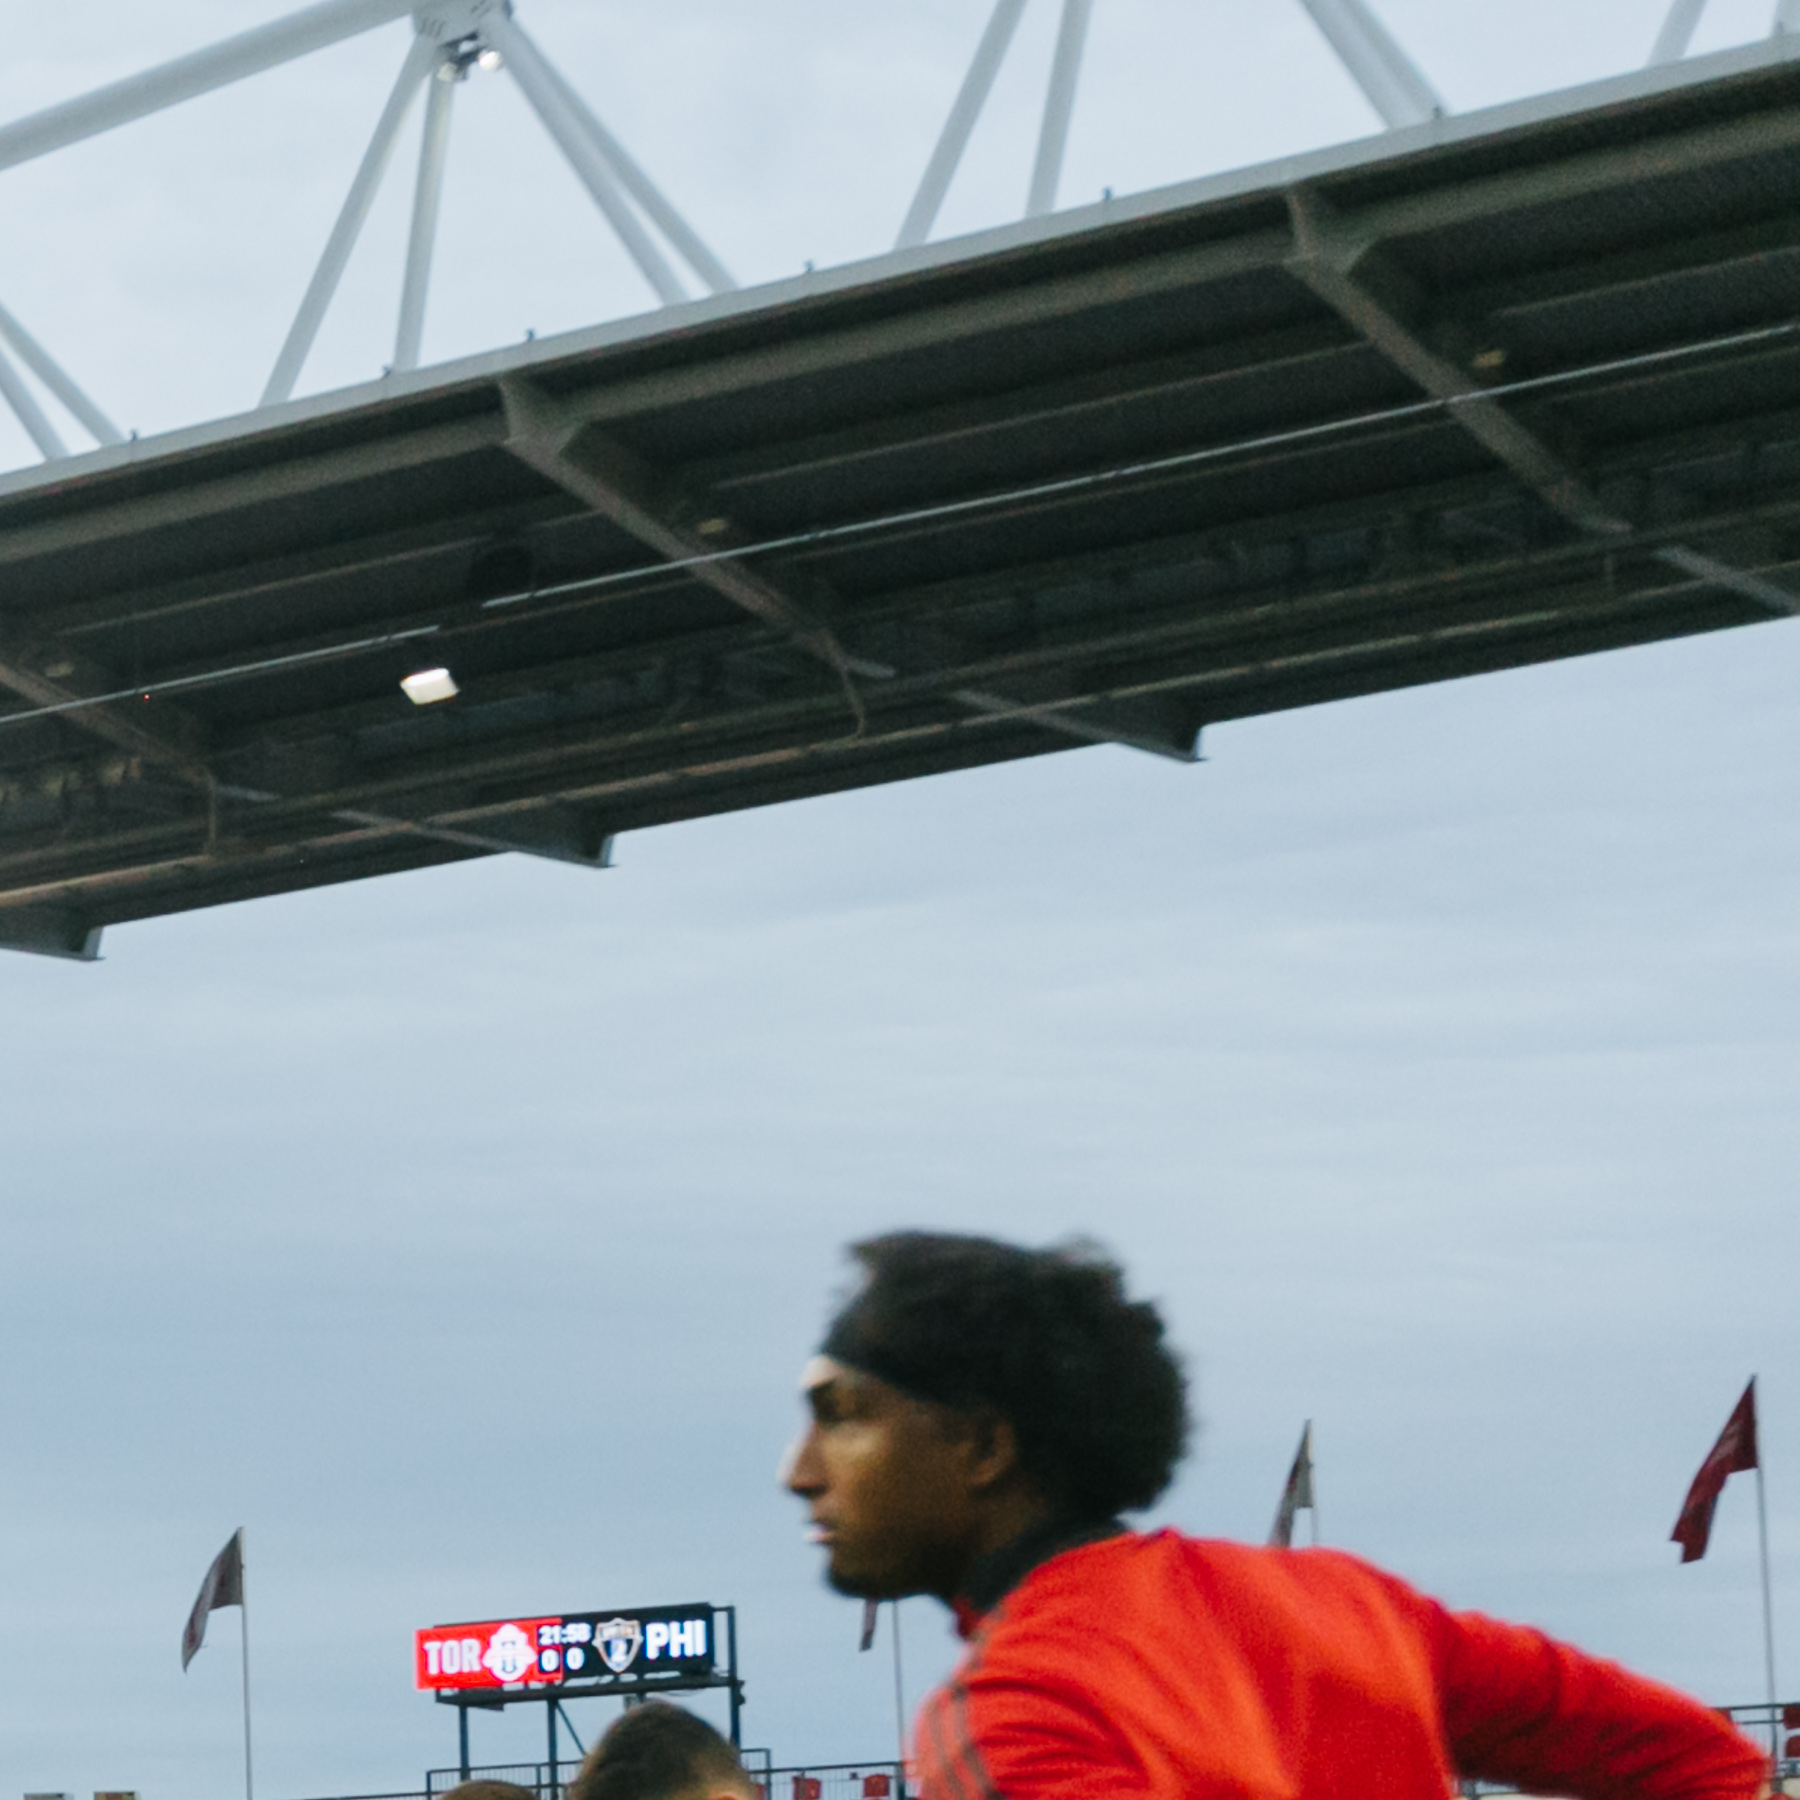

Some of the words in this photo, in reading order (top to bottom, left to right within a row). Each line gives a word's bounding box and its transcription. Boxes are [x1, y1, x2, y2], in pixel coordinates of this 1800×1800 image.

[645, 1619, 707, 1660] PHI
[424, 1639, 481, 1675] TOR
[541, 1648, 559, 1672] 0
[565, 1647, 585, 1670] 0
